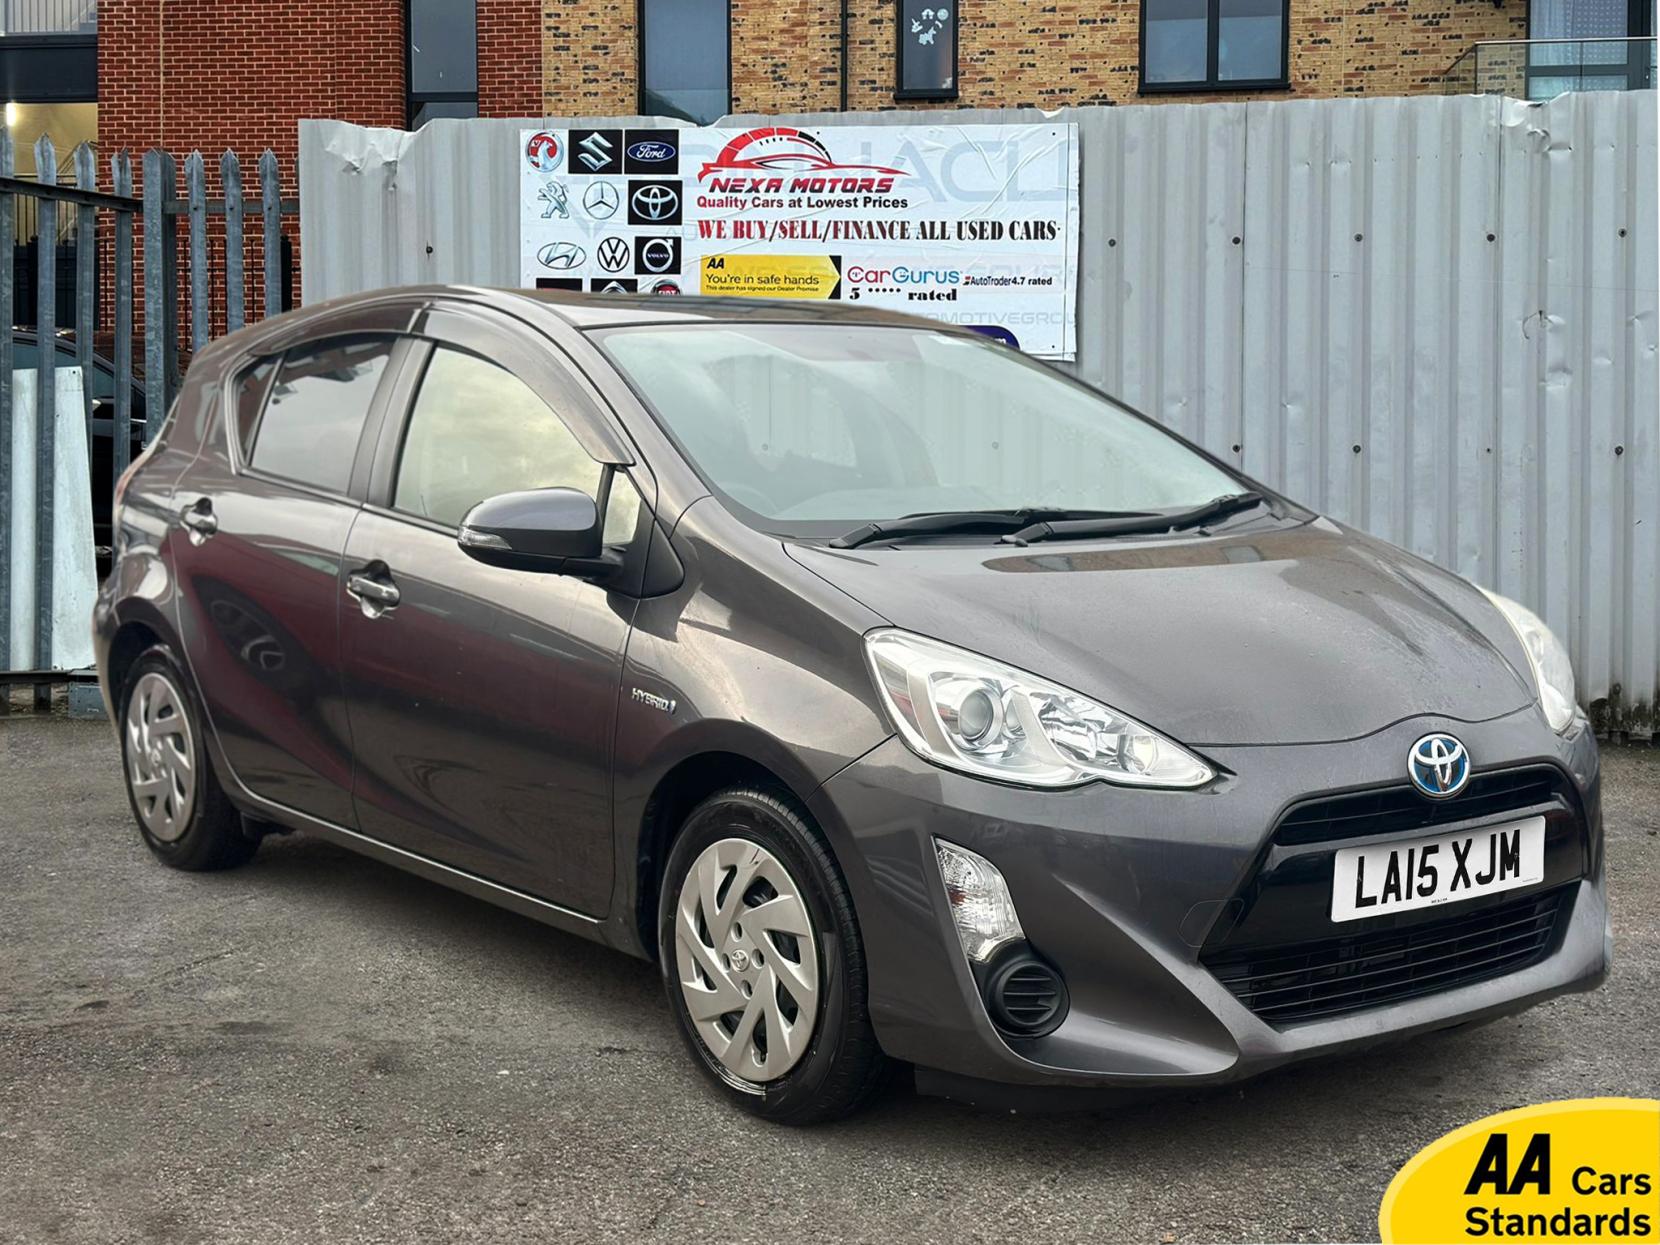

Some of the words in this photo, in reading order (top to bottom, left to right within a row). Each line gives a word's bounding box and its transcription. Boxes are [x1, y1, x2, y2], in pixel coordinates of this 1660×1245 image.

[636, 144, 667, 158] Ford
[709, 178, 784, 193] NEXA
[789, 178, 895, 193] MOTORS
[697, 196, 747, 210] Quality
[752, 197, 784, 208] Cars
[788, 198, 803, 208] at
[807, 197, 858, 208] Lowest
[863, 198, 908, 208] Prices
[698, 220, 727, 239] WE
[733, 220, 910, 242] BUY/SELL/FINANCE
[916, 221, 951, 240] ALL
[957, 221, 1004, 240] USED
[1009, 220, 1057, 240] CARS
[706, 258, 725, 269] AA
[706, 273, 741, 285] You're
[744, 274, 754, 284] in
[757, 274, 781, 285] safe
[783, 274, 820, 285] hands
[847, 266, 960, 284] CarGurus
[1028, 276, 1052, 285] rated
[849, 287, 860, 300] 5
[908, 288, 957, 301] rated
[631, 687, 669, 712] HYBRID
[1355, 844, 1440, 908] LA15
[1450, 829, 1521, 892] XJM
